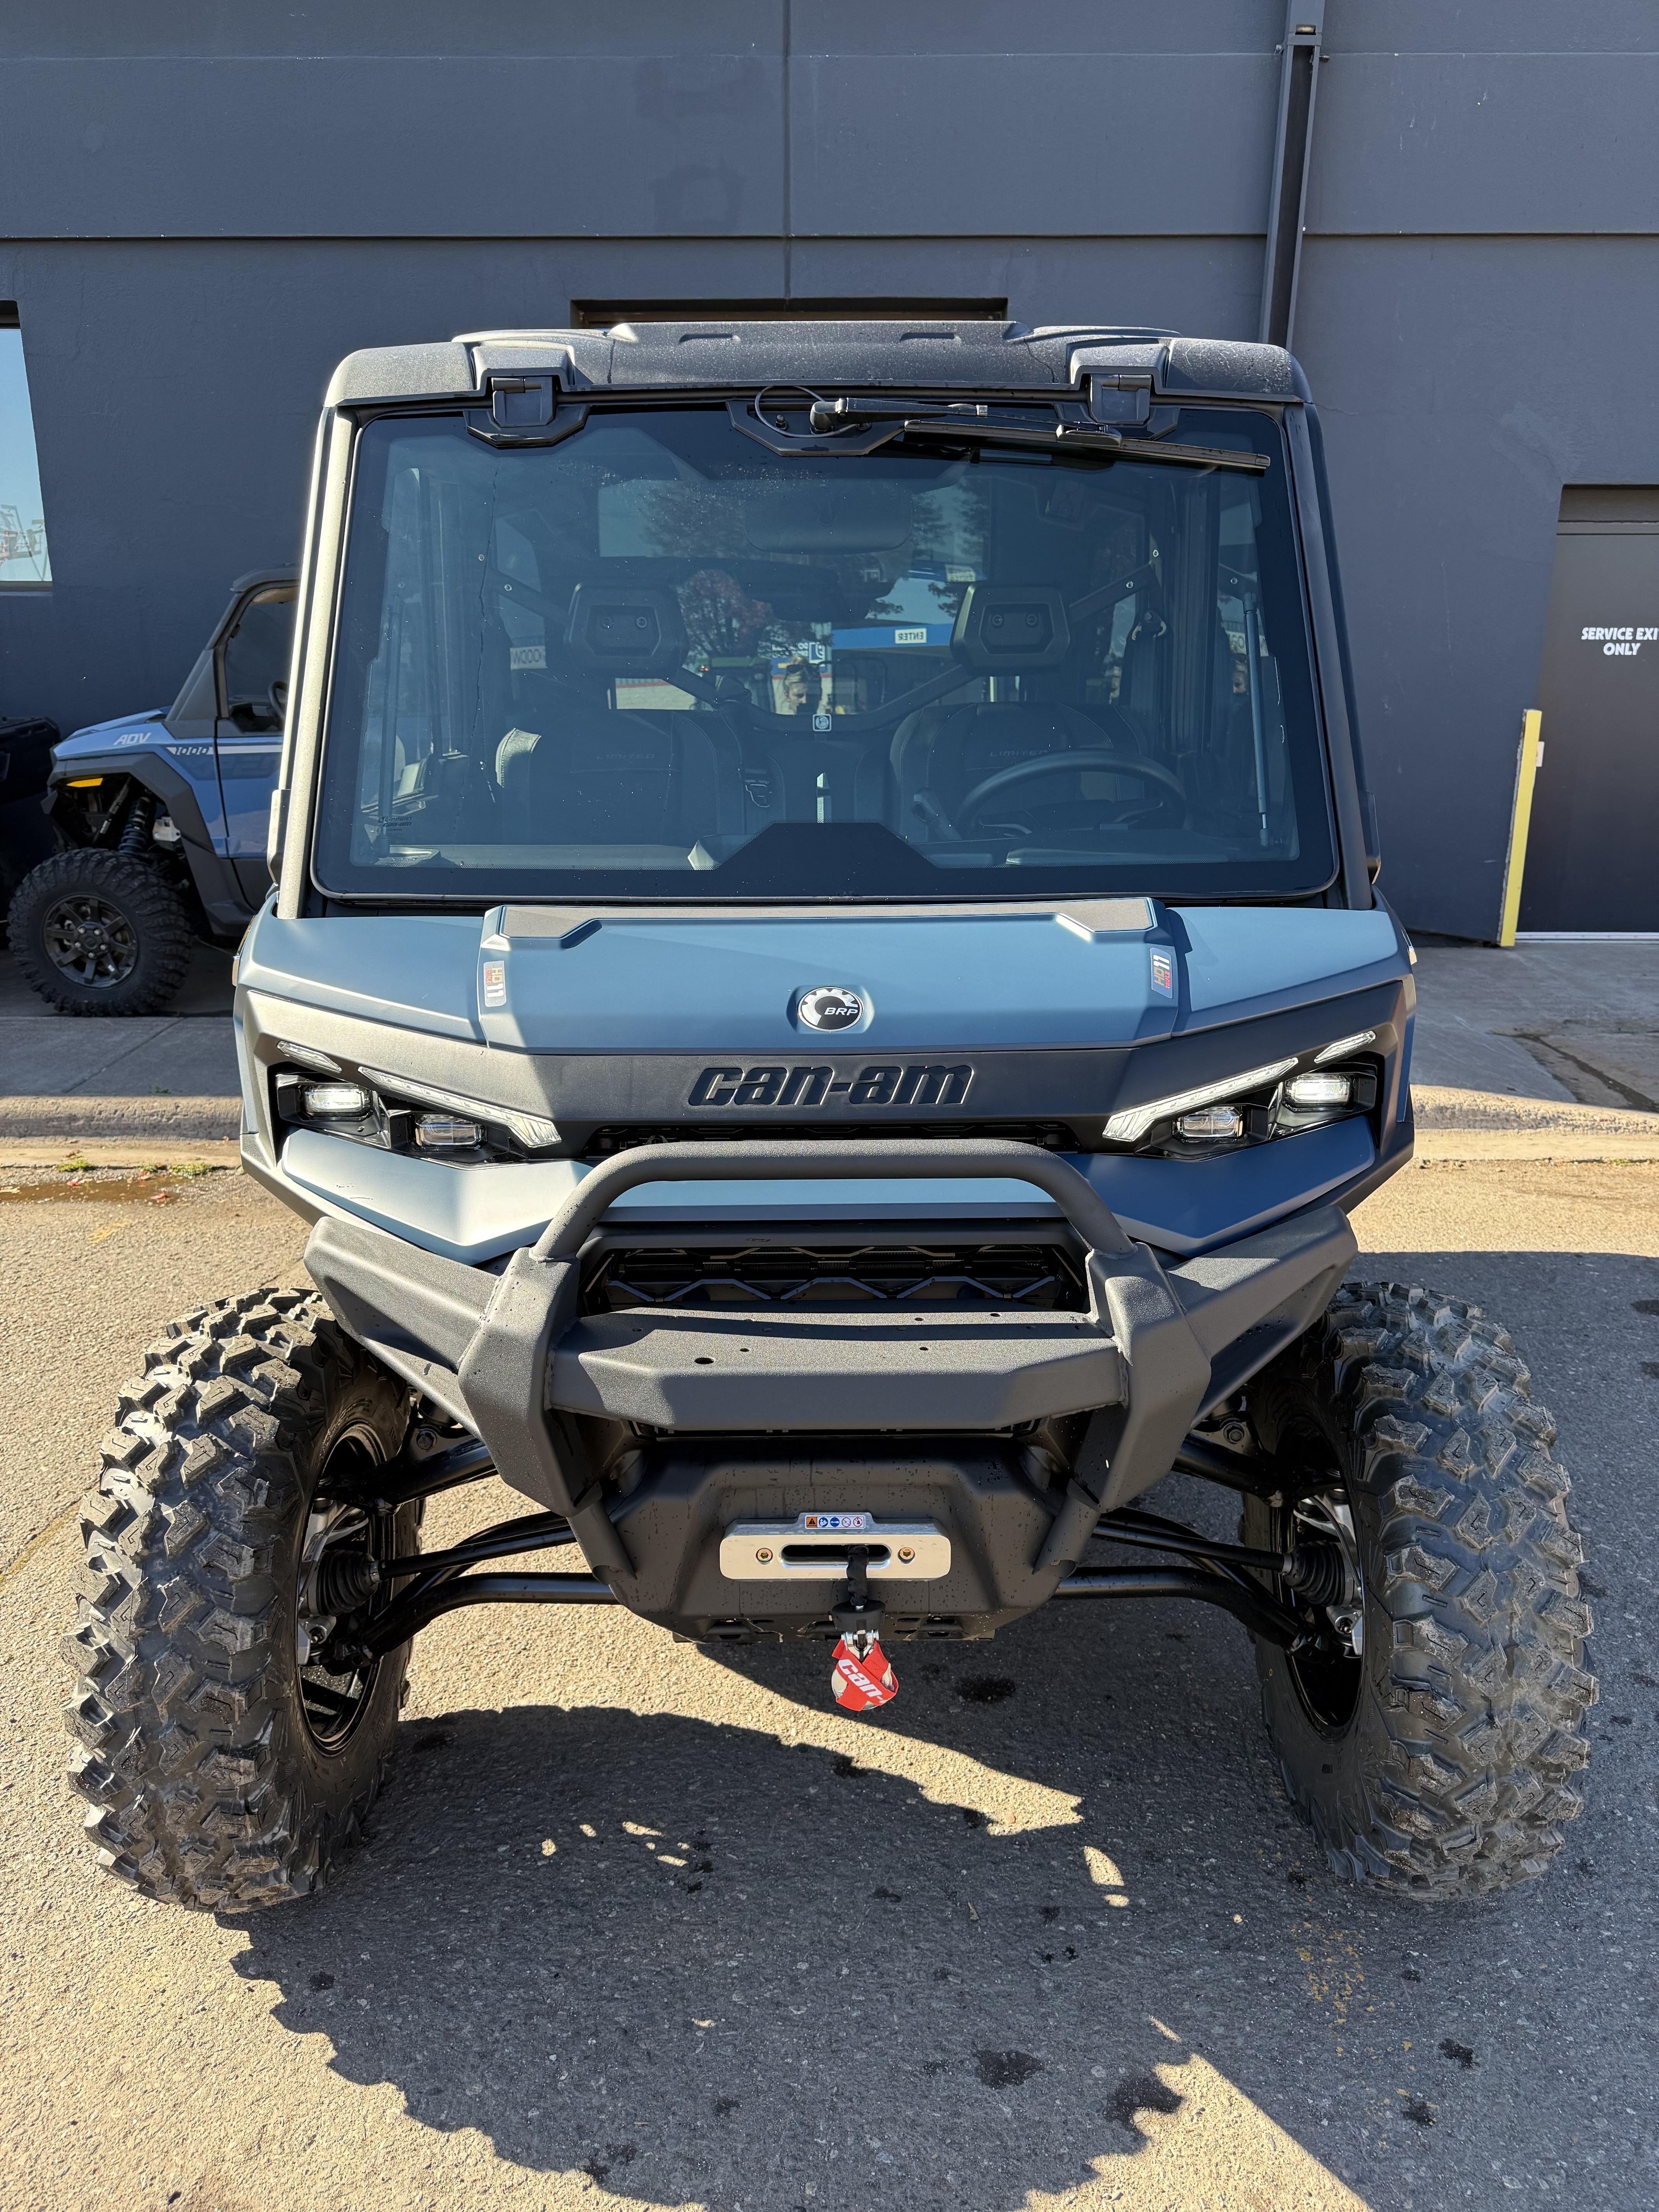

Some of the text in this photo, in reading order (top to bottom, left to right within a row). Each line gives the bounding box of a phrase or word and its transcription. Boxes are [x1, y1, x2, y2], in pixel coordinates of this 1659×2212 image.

[1581, 627, 1659, 640] SERVICE EXI
[1603, 642, 1641, 655] ONLY
[113, 732, 151, 746] ADV
[1153, 955, 1170, 986] HD11
[486, 967, 504, 998] HD11
[824, 1007, 858, 1016] BRP
[688, 1066, 974, 1106] can-am
